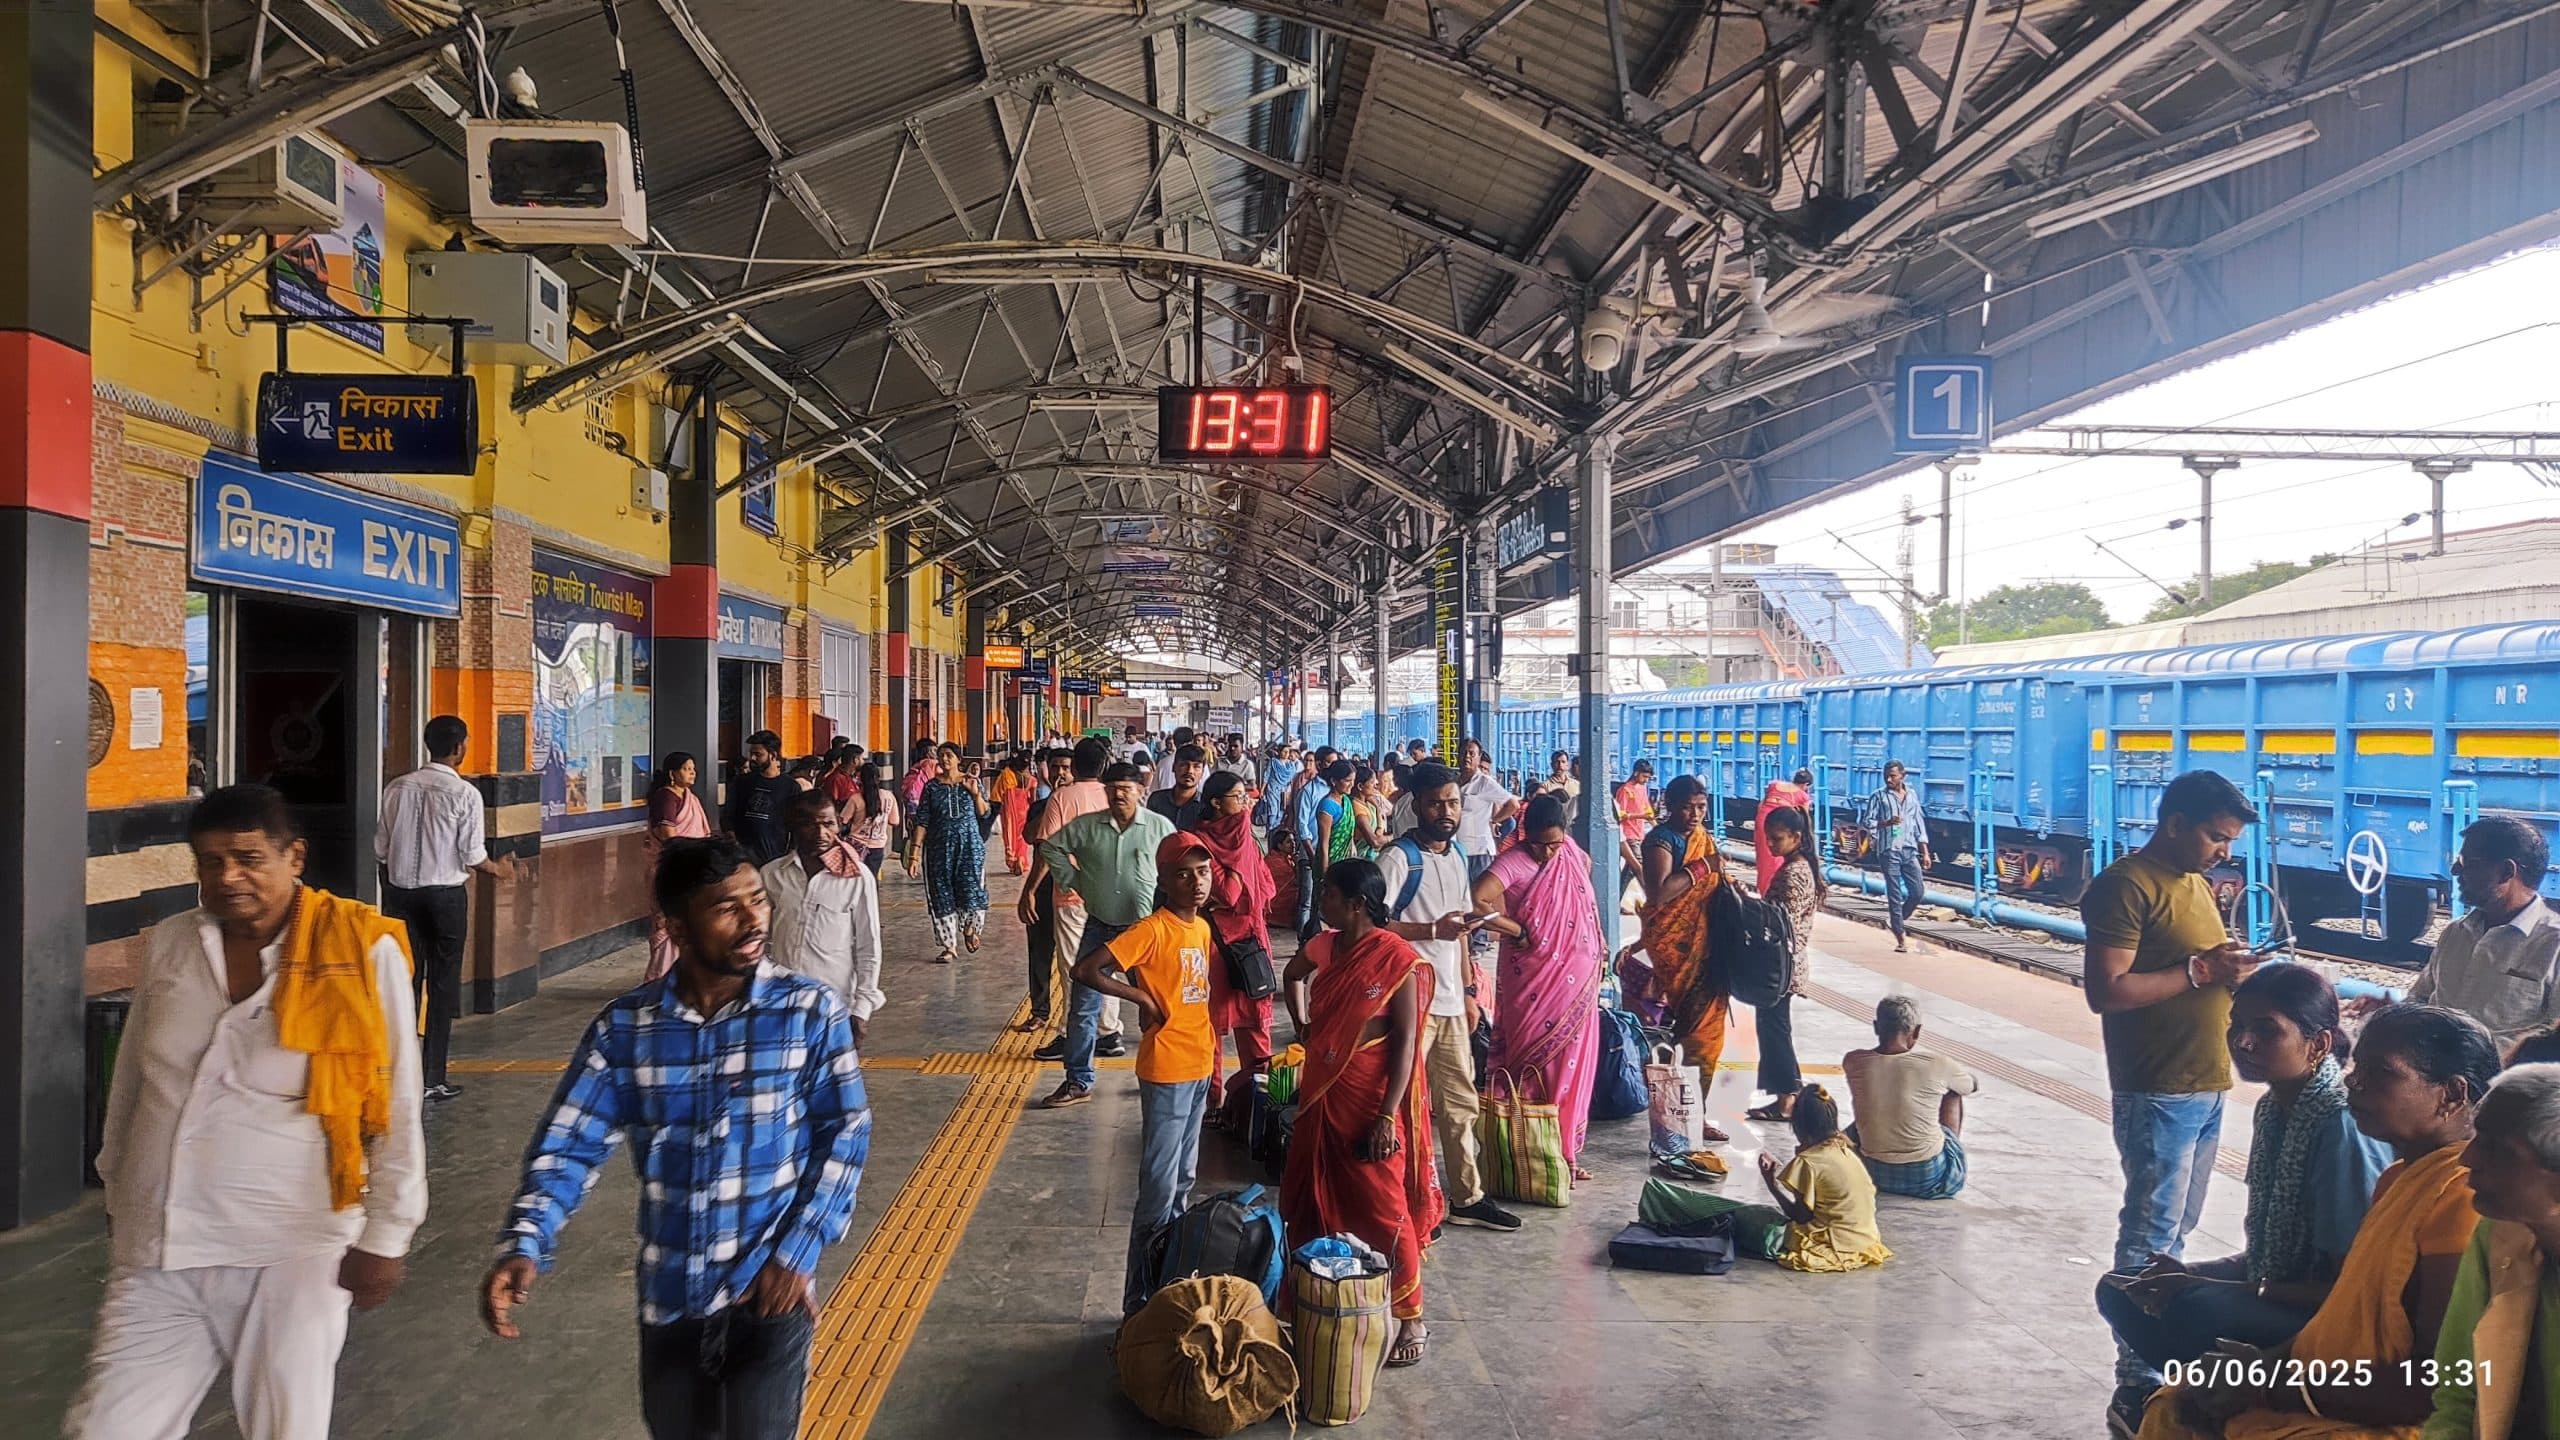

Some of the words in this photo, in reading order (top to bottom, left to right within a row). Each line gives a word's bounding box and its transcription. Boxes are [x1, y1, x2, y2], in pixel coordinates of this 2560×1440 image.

[339, 387, 444, 419] निकास
[1933, 374, 1961, 430] 1
[337, 426, 394, 451] Exit
[1189, 393, 1323, 451] 13:31
[216, 483, 336, 569] निकास
[362, 519, 451, 589] EXIT
[531, 571, 549, 597] टक
[589, 582, 624, 613] Tourist
[625, 591, 645, 623] Map
[749, 615, 781, 650] ENTRANCE
[2495, 686, 2507, 705] N
[2516, 684, 2528, 704] R
[1670, 1107, 1690, 1116] Yara
